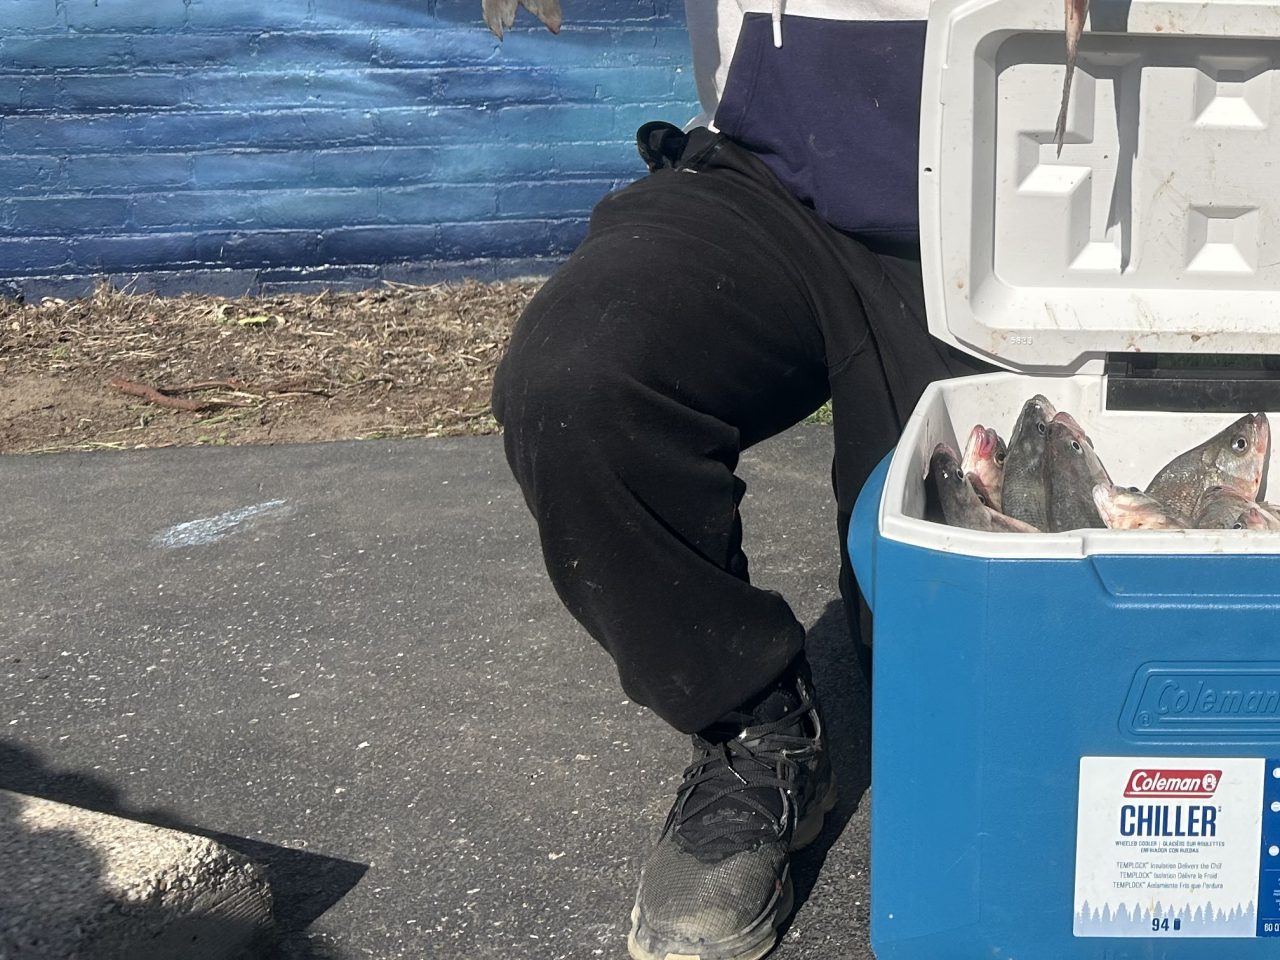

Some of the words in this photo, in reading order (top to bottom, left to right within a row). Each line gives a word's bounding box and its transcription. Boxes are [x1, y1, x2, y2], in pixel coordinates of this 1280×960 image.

[1157, 679, 1280, 715] Coleman
[1131, 772, 1201, 791] Coleman
[1120, 805, 1217, 837] CHILLER
[1152, 918, 1169, 931] 94
